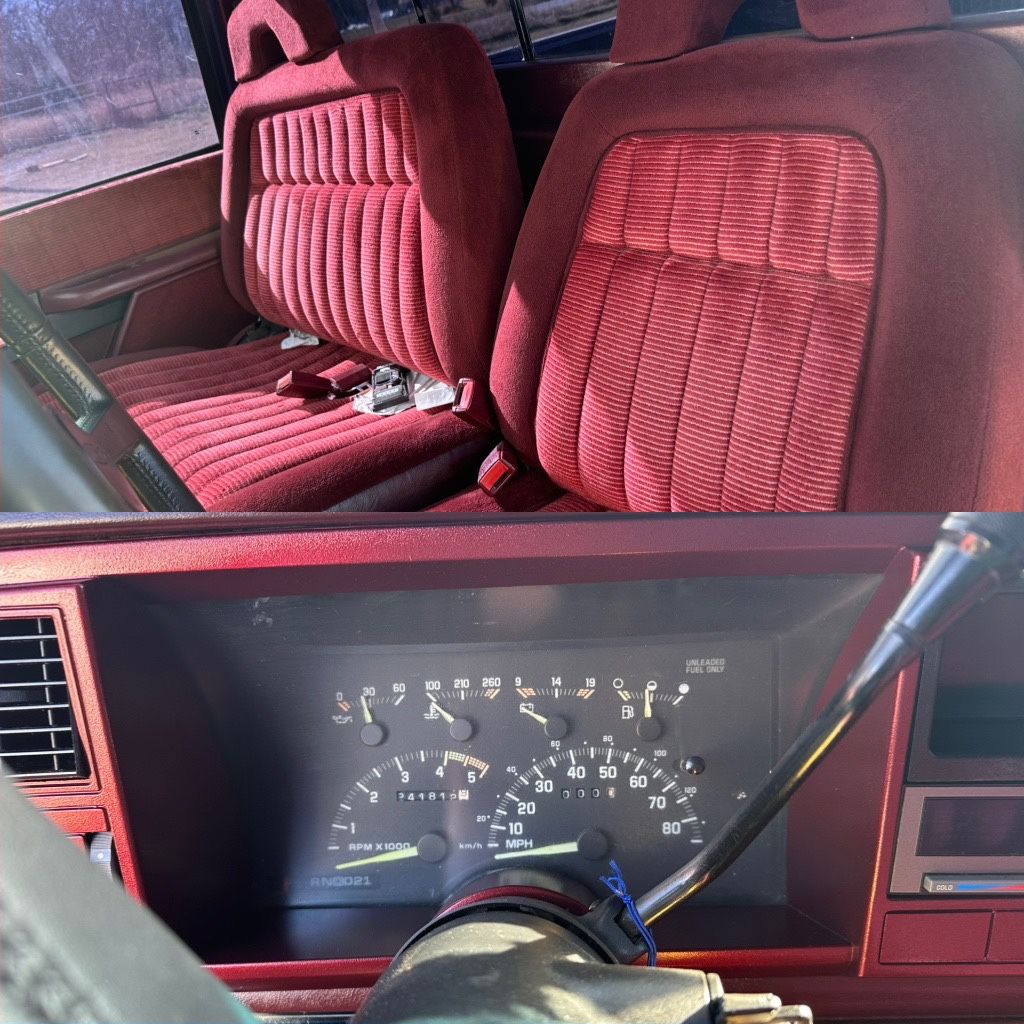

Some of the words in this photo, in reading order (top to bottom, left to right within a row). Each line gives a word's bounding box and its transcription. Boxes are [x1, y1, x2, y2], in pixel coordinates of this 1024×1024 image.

[686, 658, 725, 666] UNLEADED
[706, 665, 725, 673] ONLY
[425, 681, 441, 690] 100
[454, 679, 470, 689] 210
[482, 677, 501, 687] 260
[514, 677, 522, 687] 9
[551, 677, 562, 687] 14
[585, 678, 596, 688] 19
[362, 687, 376, 697] 30
[393, 683, 406, 693] 60
[550, 740, 561, 748] 60
[602, 735, 613, 743] 80
[435, 766, 444, 778] 4
[506, 766, 517, 774] 40
[566, 766, 586, 779] 40
[599, 766, 617, 779] 50
[401, 771, 410, 783] 3
[467, 771, 476, 783] 5
[629, 776, 648, 788] 60
[535, 780, 553, 793] 30
[684, 786, 697, 794] 120
[369, 791, 379, 803] 2
[648, 796, 666, 809] 70
[517, 802, 536, 815] 20
[350, 822, 356, 835] 1
[509, 822, 523, 835] 10
[662, 822, 681, 835] 80
[349, 842, 373, 851] RPM
[459, 842, 483, 850] km/h
[506, 839, 533, 849] MPH
